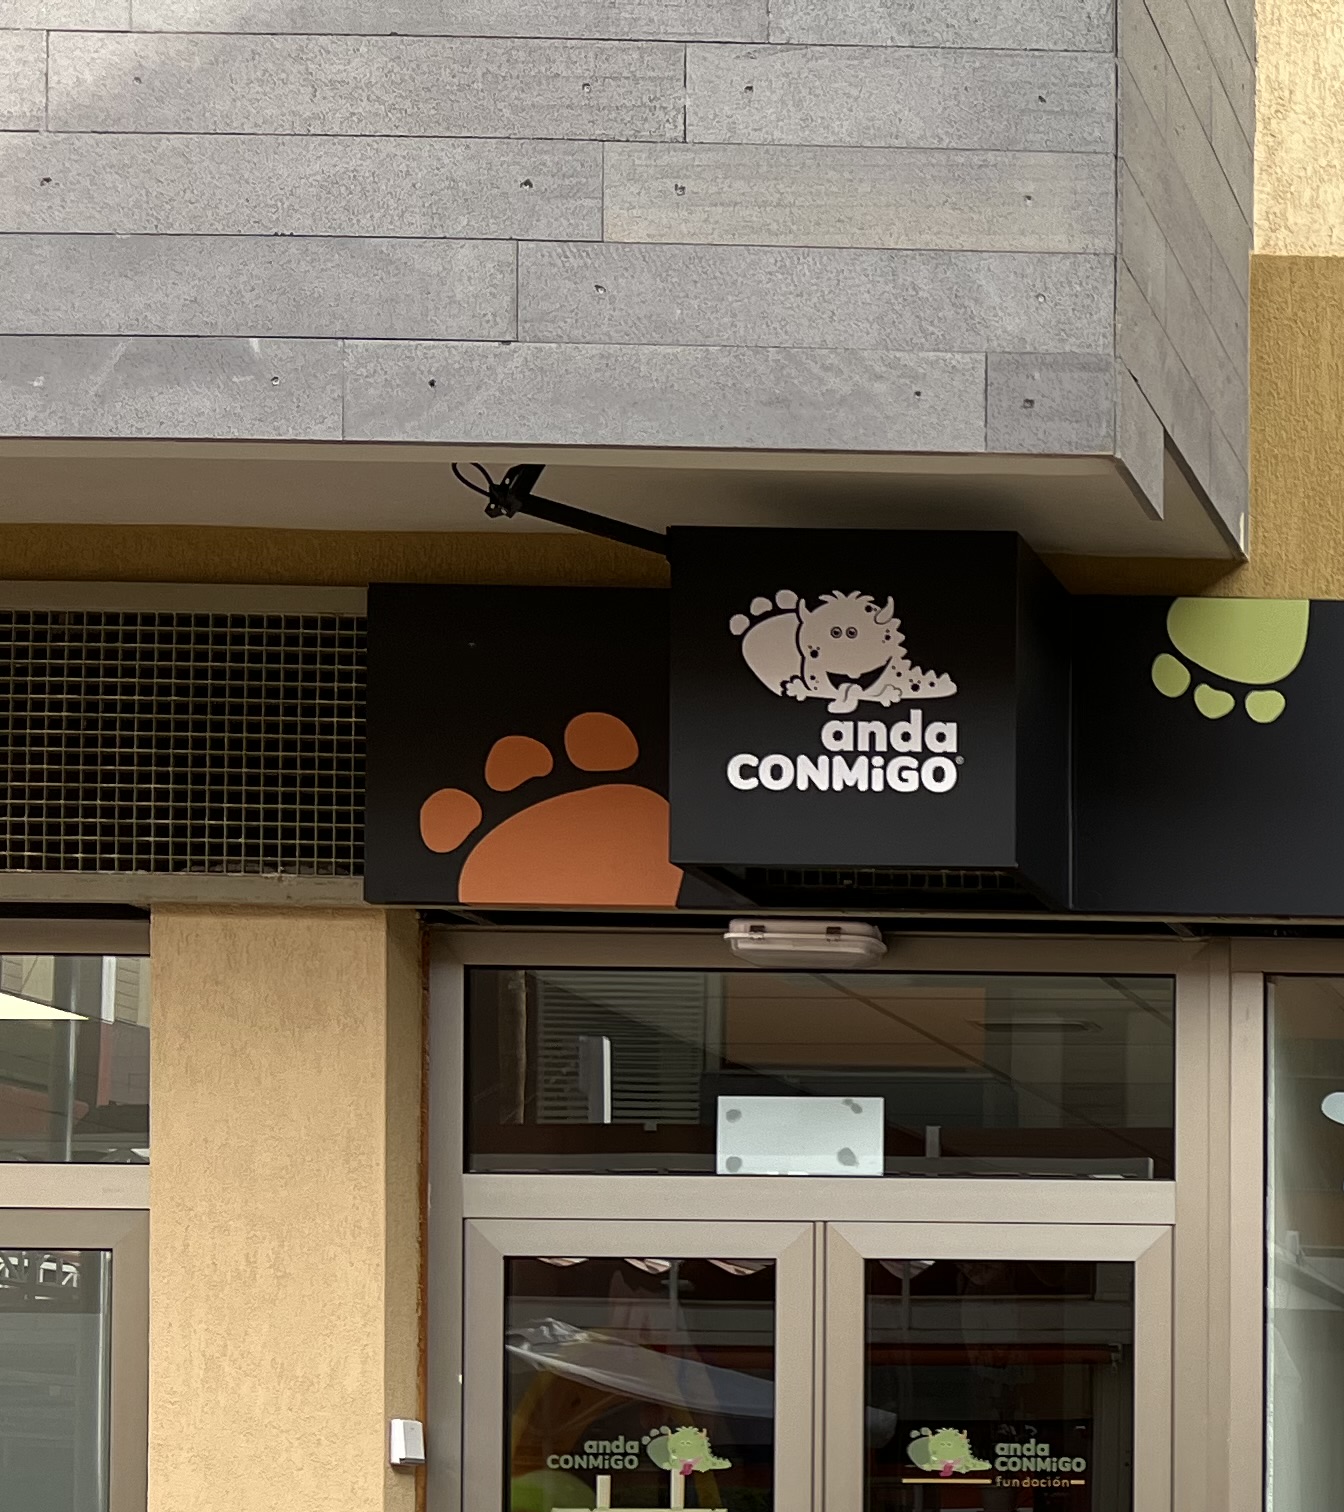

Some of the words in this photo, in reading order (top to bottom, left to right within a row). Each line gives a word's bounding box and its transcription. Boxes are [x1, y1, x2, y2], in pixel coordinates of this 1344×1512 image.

[820, 708, 958, 753] anda
[584, 1436, 640, 1454] anda
[995, 1439, 1050, 1457] anda
[995, 1475, 1070, 1488] fundación
